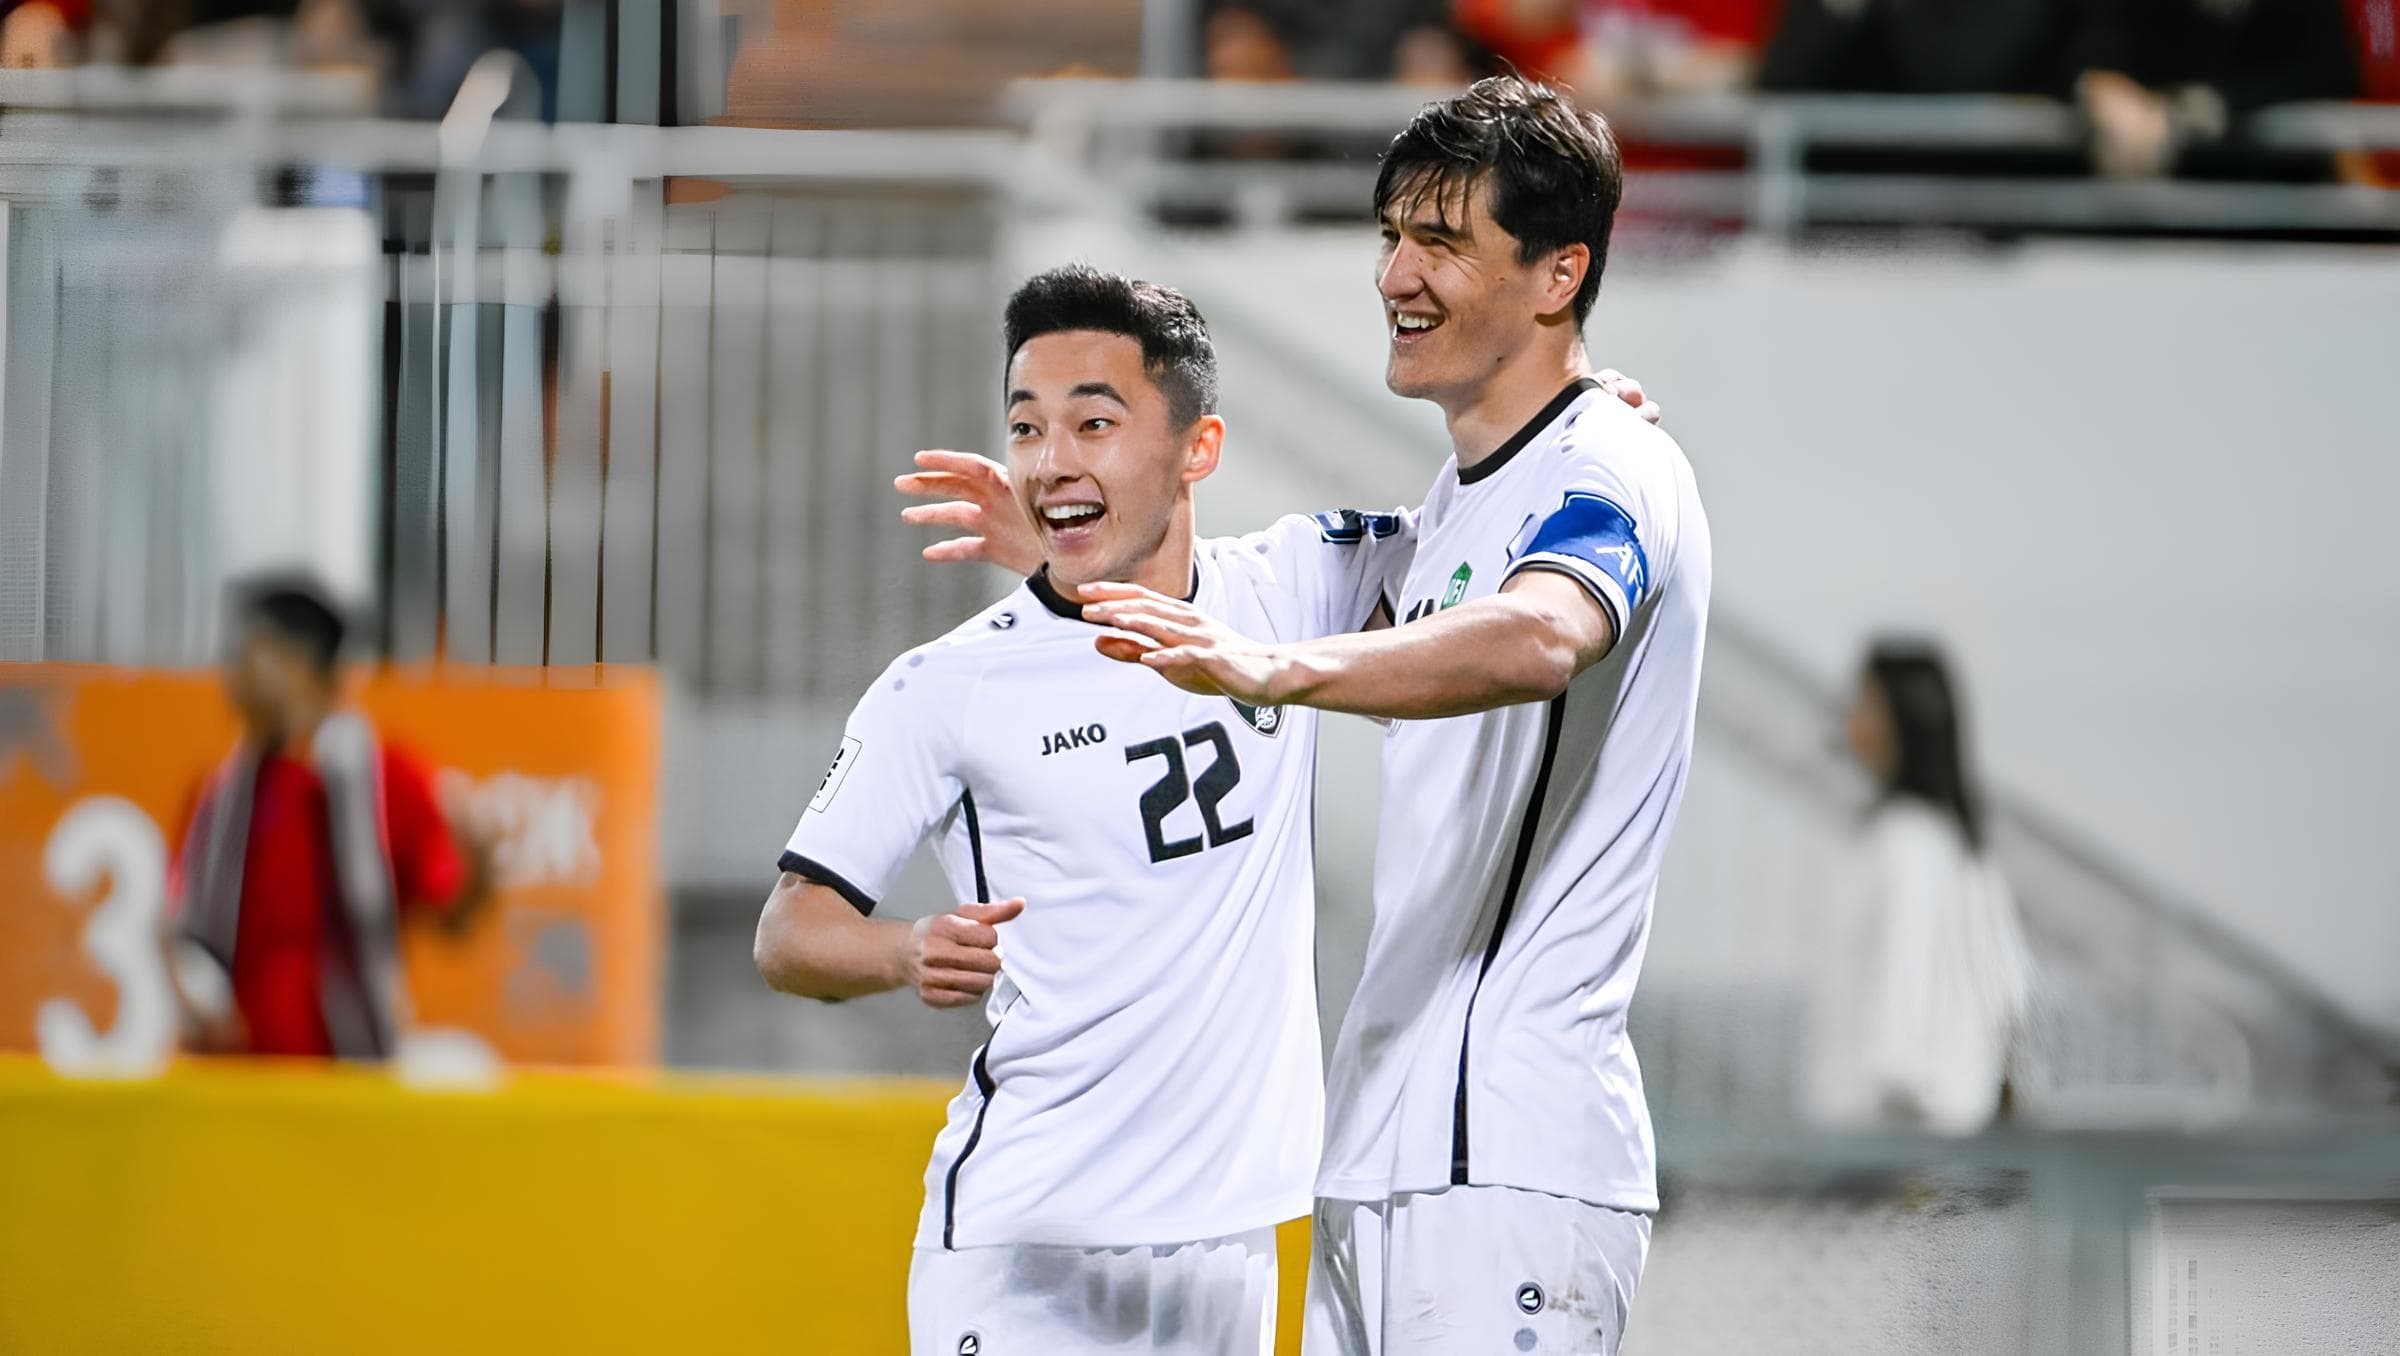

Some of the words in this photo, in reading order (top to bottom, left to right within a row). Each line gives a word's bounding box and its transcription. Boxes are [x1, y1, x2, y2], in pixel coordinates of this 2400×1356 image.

[1041, 723, 1107, 756] JAKO
[1124, 720, 1254, 864] 22
[38, 796, 176, 1080] 3
